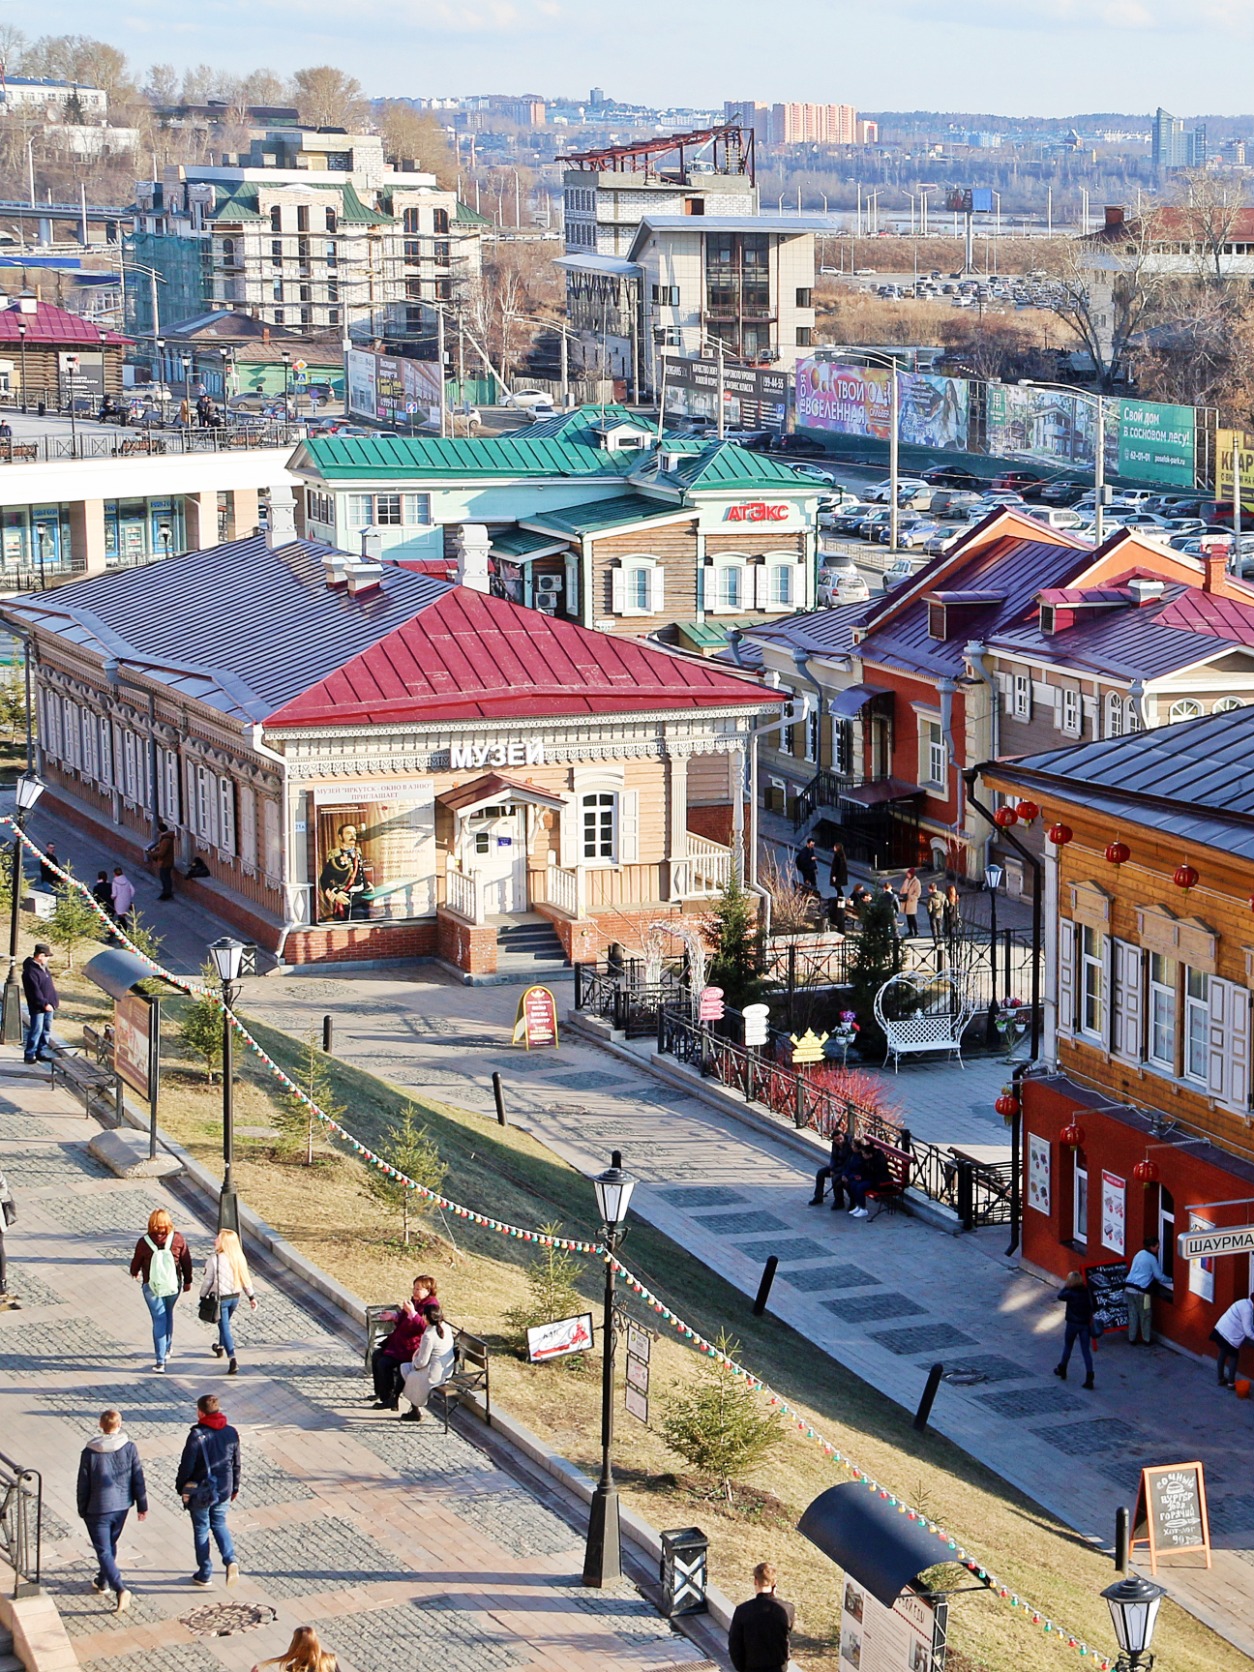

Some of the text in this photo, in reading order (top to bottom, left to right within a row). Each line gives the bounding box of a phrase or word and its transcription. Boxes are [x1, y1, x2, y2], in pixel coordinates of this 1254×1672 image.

[837, 379, 865, 402] ТВОЙ
[805, 397, 865, 424] ВСЕЛЕННАЯ
[1124, 407, 1160, 426] Свой дом
[1130, 427, 1167, 442] сосновом
[1168, 431, 1190, 448] лесу!
[727, 502, 789, 521] АТЭКС
[451, 737, 545, 768] МУЗЕЙ
[316, 786, 341, 795] МУЗЕЙ
[351, 792, 398, 800] ПРИГЛАШАЕТ
[1189, 1233, 1254, 1253] ШАУРМА
[1156, 1472, 1196, 1490] СОЧНЫЙ
